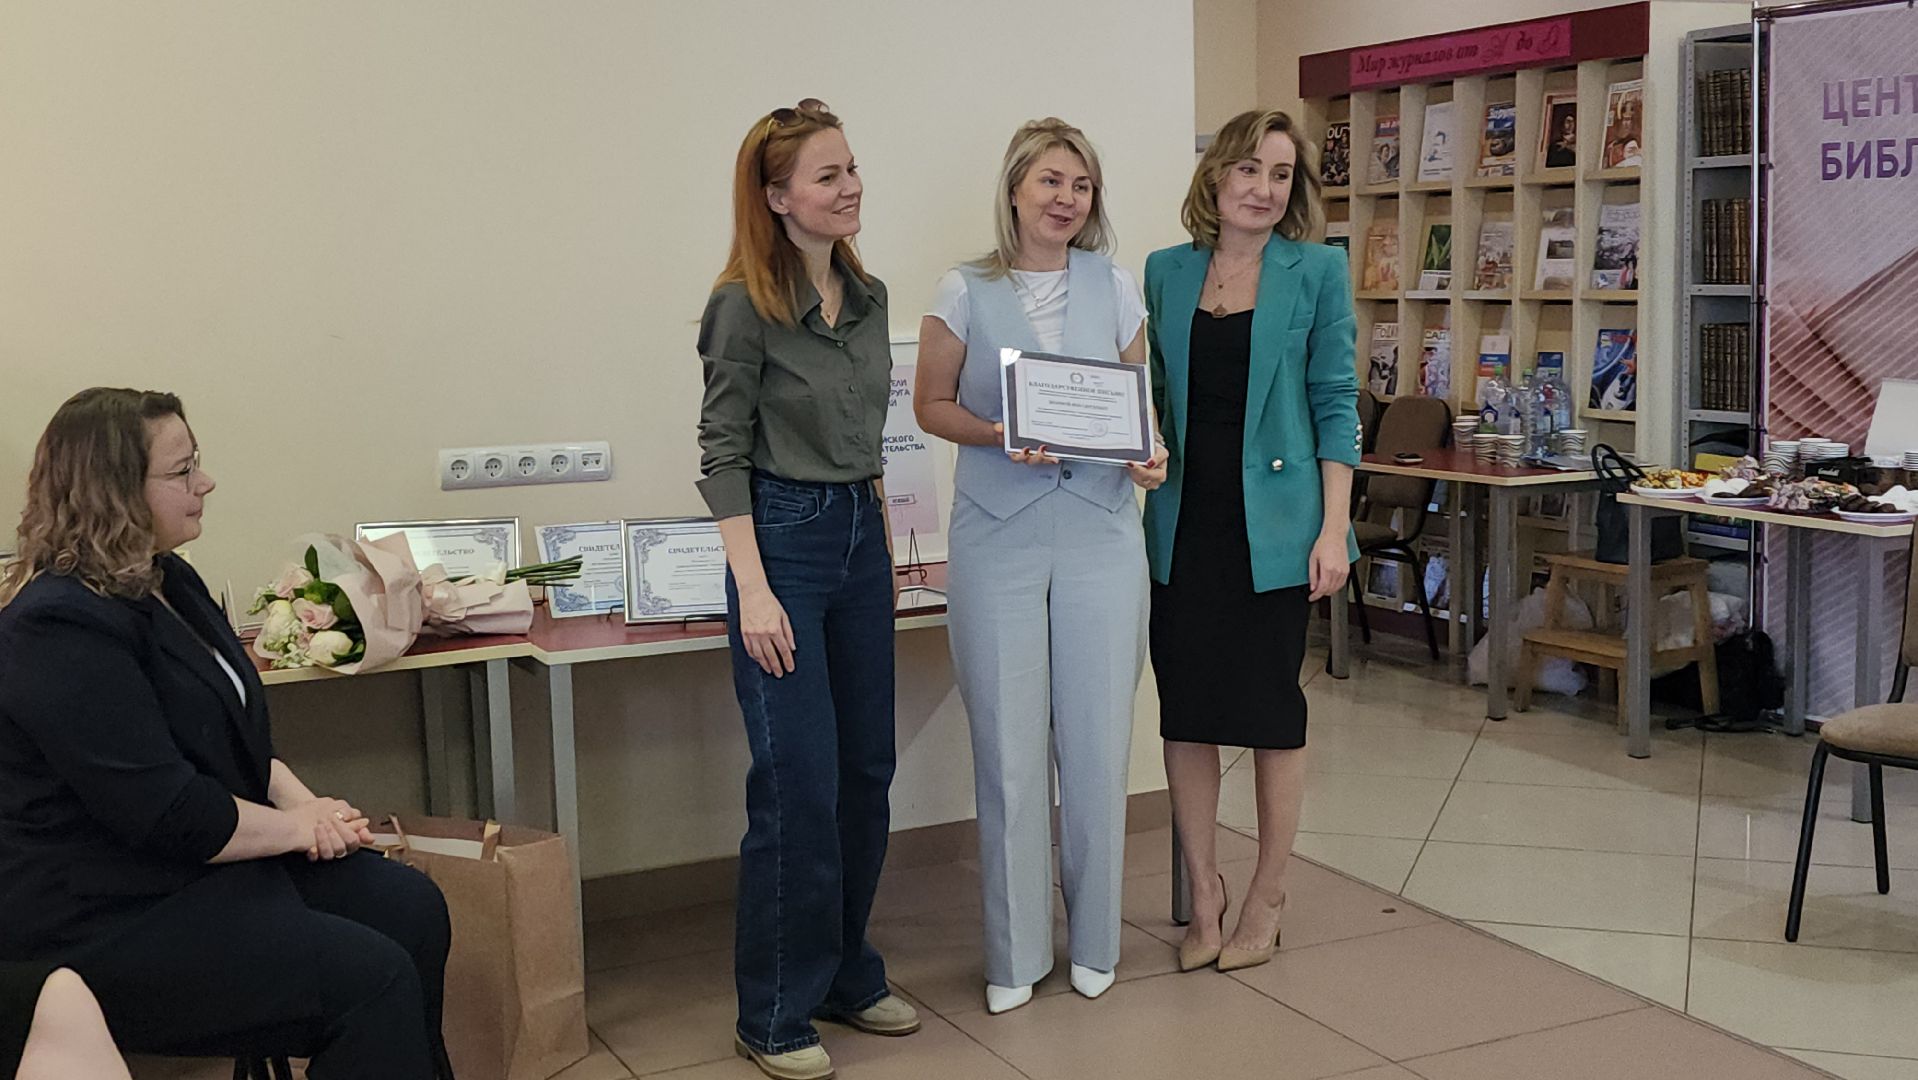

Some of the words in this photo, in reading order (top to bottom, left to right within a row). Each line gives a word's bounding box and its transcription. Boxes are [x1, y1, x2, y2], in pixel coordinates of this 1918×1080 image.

[1355, 54, 1386, 78] Мир
[1387, 47, 1453, 75] журналов
[1516, 30, 1533, 51] до
[1822, 74, 1918, 127] ЦЕНТ
[1821, 138, 1918, 181] БИБЛ
